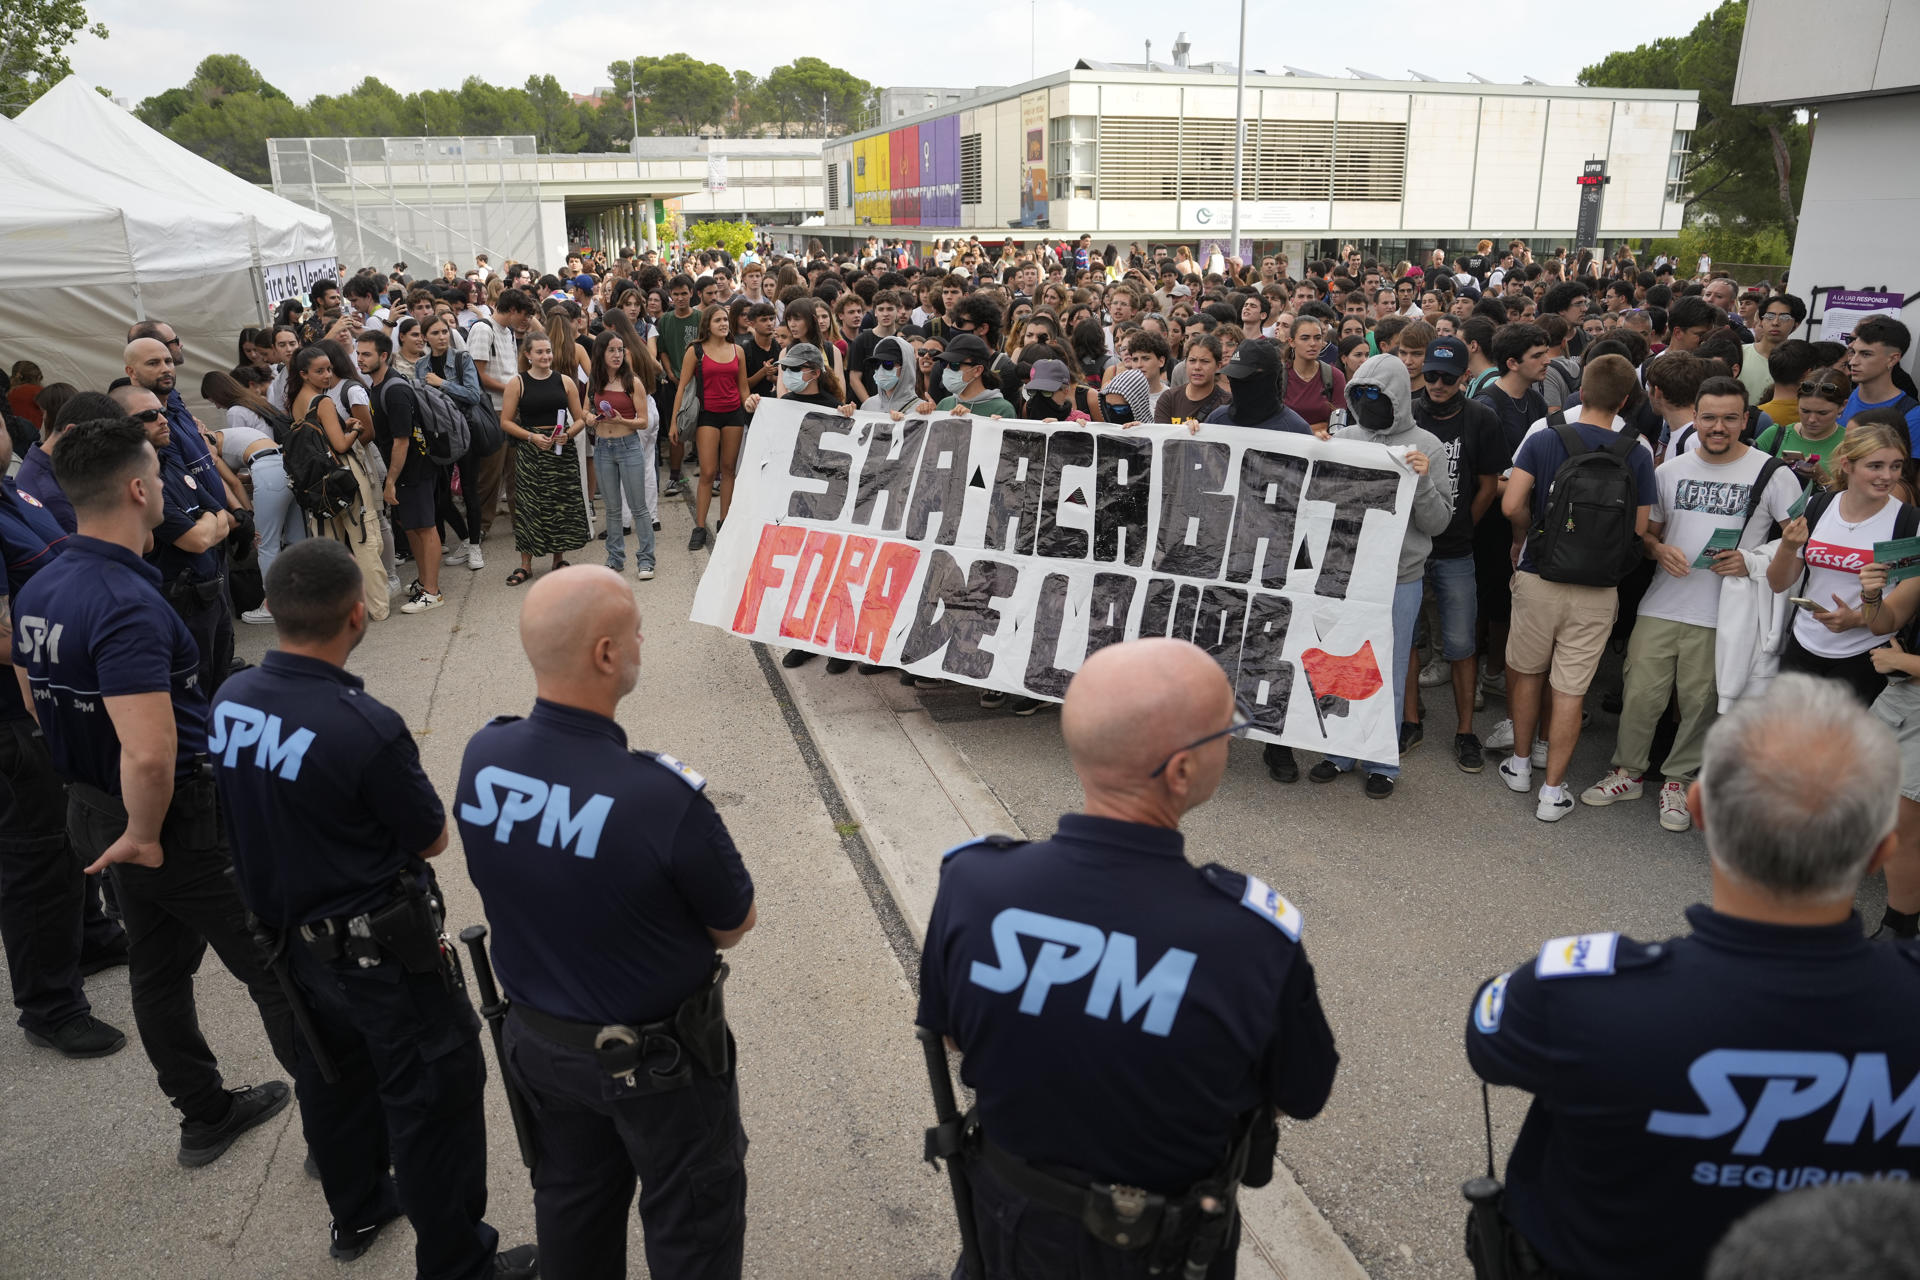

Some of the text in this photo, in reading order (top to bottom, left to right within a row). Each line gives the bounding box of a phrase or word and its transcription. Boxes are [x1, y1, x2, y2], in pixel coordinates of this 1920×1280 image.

[264, 267, 284, 301] ira
[285, 264, 299, 297] de
[984, 429, 1401, 600] ACABAT
[1687, 485, 1742, 510] FRESH
[732, 524, 921, 663] FORA
[900, 549, 1019, 680] DE
[208, 700, 317, 782] SPM
[460, 765, 615, 859] SPM
[969, 908, 1198, 1037] SPM
[1646, 1048, 1920, 1156] SPM
